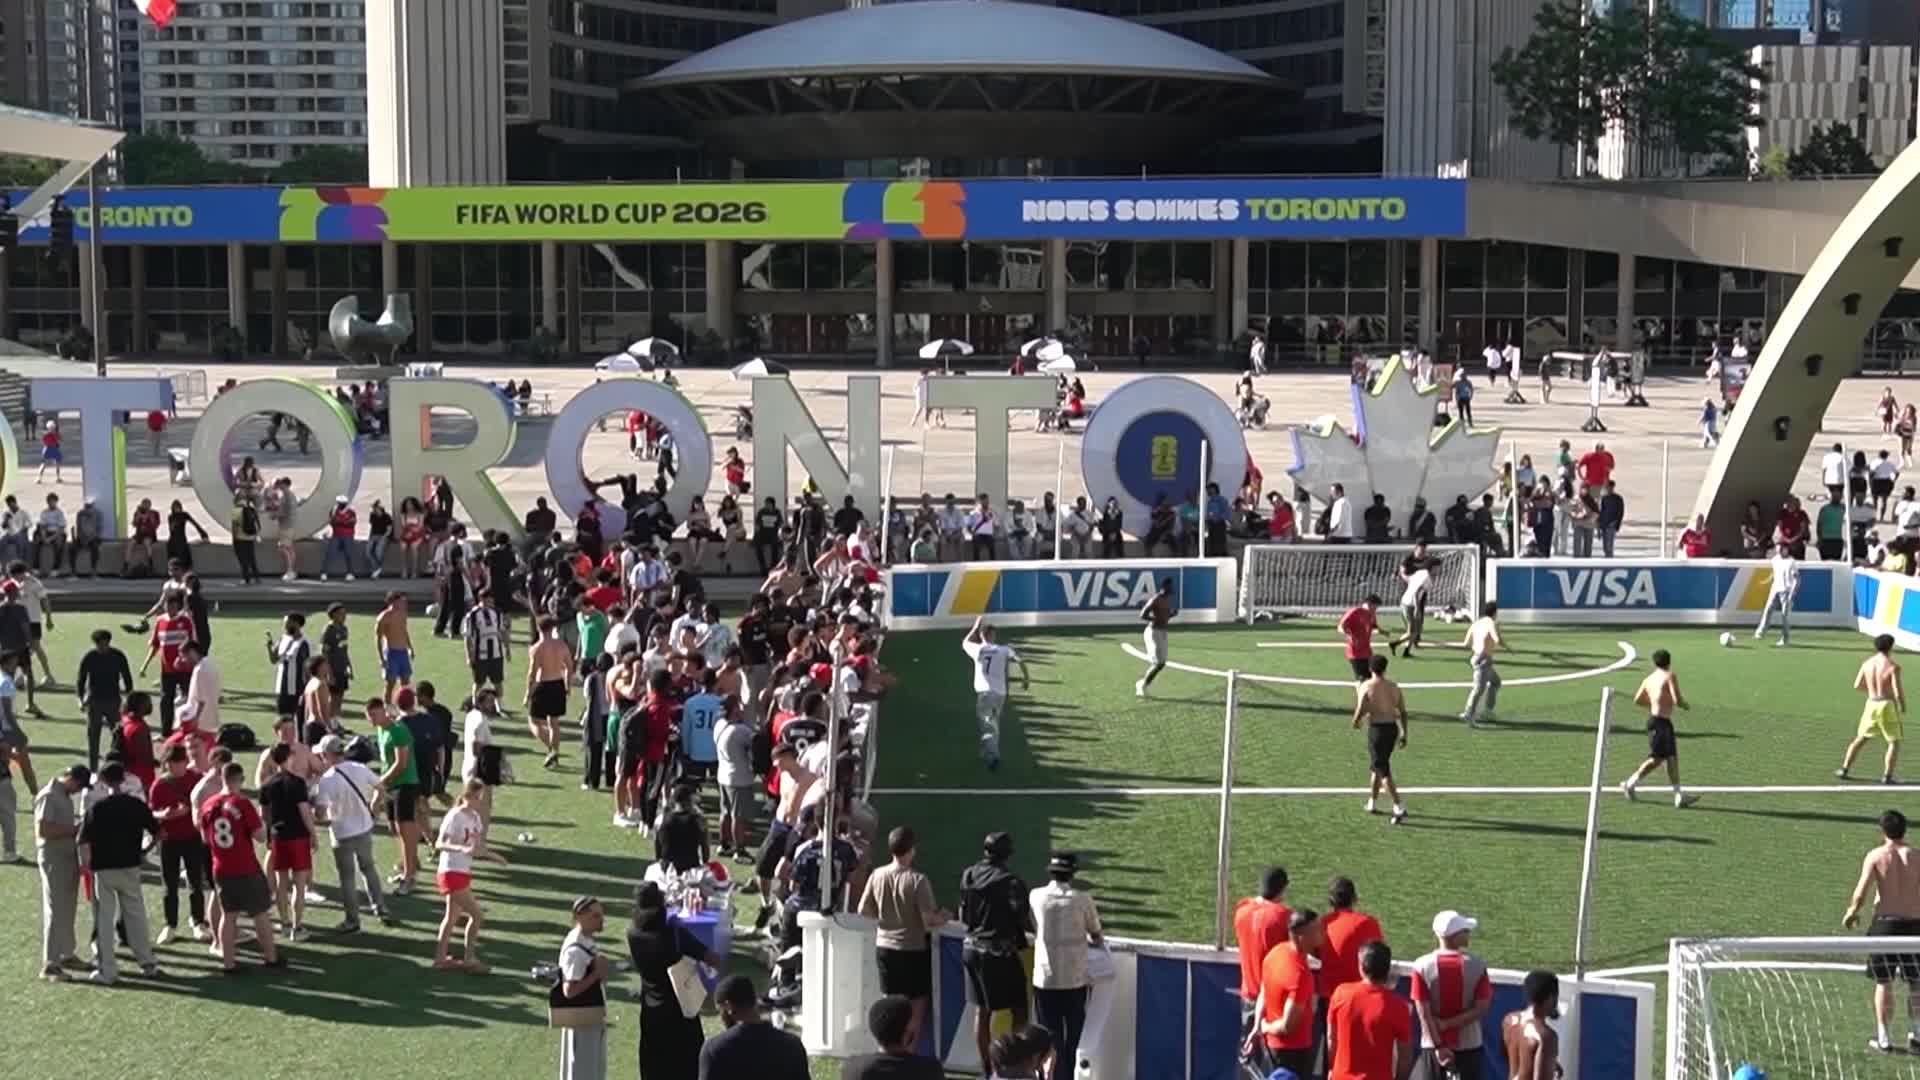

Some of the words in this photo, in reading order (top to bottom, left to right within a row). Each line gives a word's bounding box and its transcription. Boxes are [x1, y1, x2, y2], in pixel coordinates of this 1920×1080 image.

[73, 205, 193, 228] ORONTO
[456, 203, 510, 225] FIFA
[515, 202, 610, 225] WORLD
[615, 202, 667, 225] CUP
[673, 201, 767, 224] 2026
[1114, 199, 1240, 222] SOMMES
[1246, 197, 1406, 221] TORONTO
[30, 376, 1247, 541] TORONTO
[1051, 570, 1157, 607] VISA
[1548, 569, 1657, 606] VISA
[695, 709, 714, 729] 31
[214, 817, 234, 848] 8
